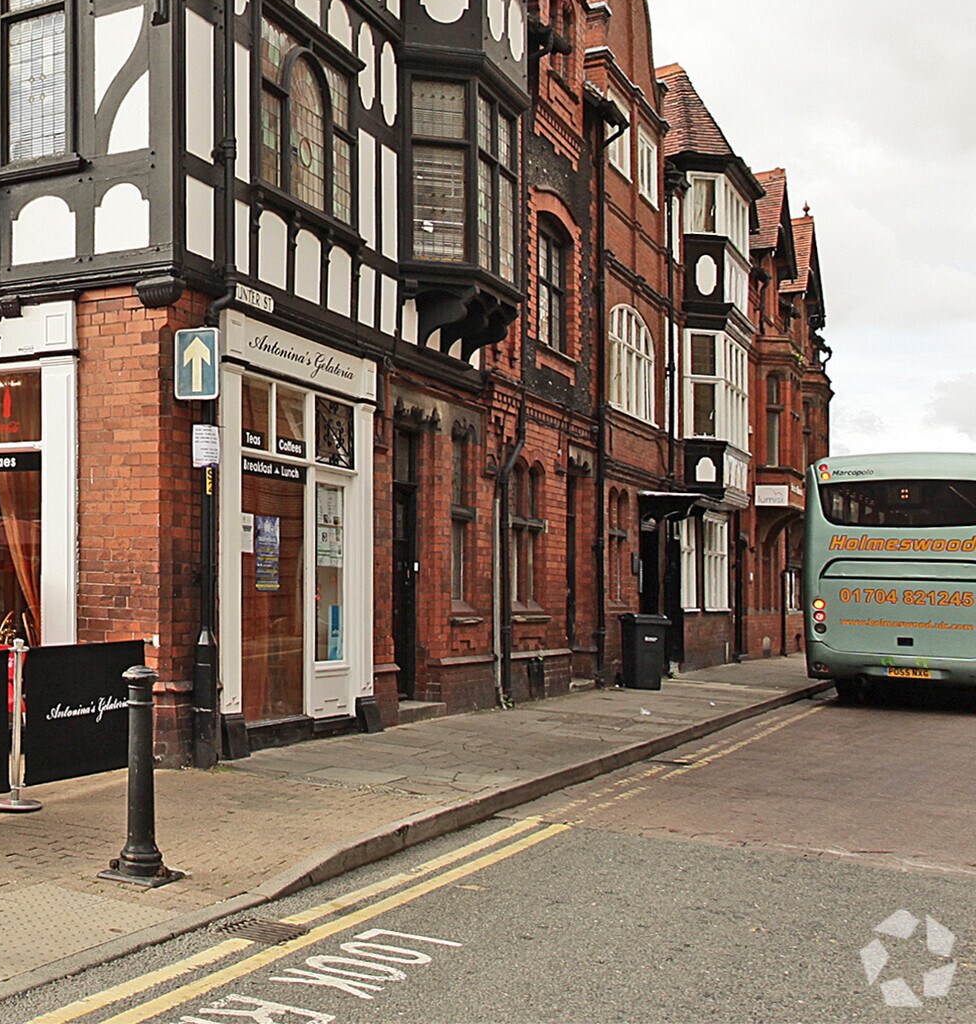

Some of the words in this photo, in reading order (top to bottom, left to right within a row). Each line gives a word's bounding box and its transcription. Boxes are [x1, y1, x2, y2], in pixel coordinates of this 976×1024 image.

[237, 286, 261, 307] UNTER
[248, 334, 312, 367] Antonina's
[310, 351, 354, 380] Gelateria
[245, 432, 261, 446] Teas
[278, 439, 302, 454] Coffees
[243, 459, 273, 474] Breakfast
[281, 466, 300, 479] Lunch
[832, 469, 874, 477] Marcopolo
[829, 534, 976, 553] Holmeswood
[839, 587, 898, 605] 01704
[903, 590, 974, 607] 821245
[46, 703, 96, 720] Antonina's
[268, 928, 463, 1000] LOOK
